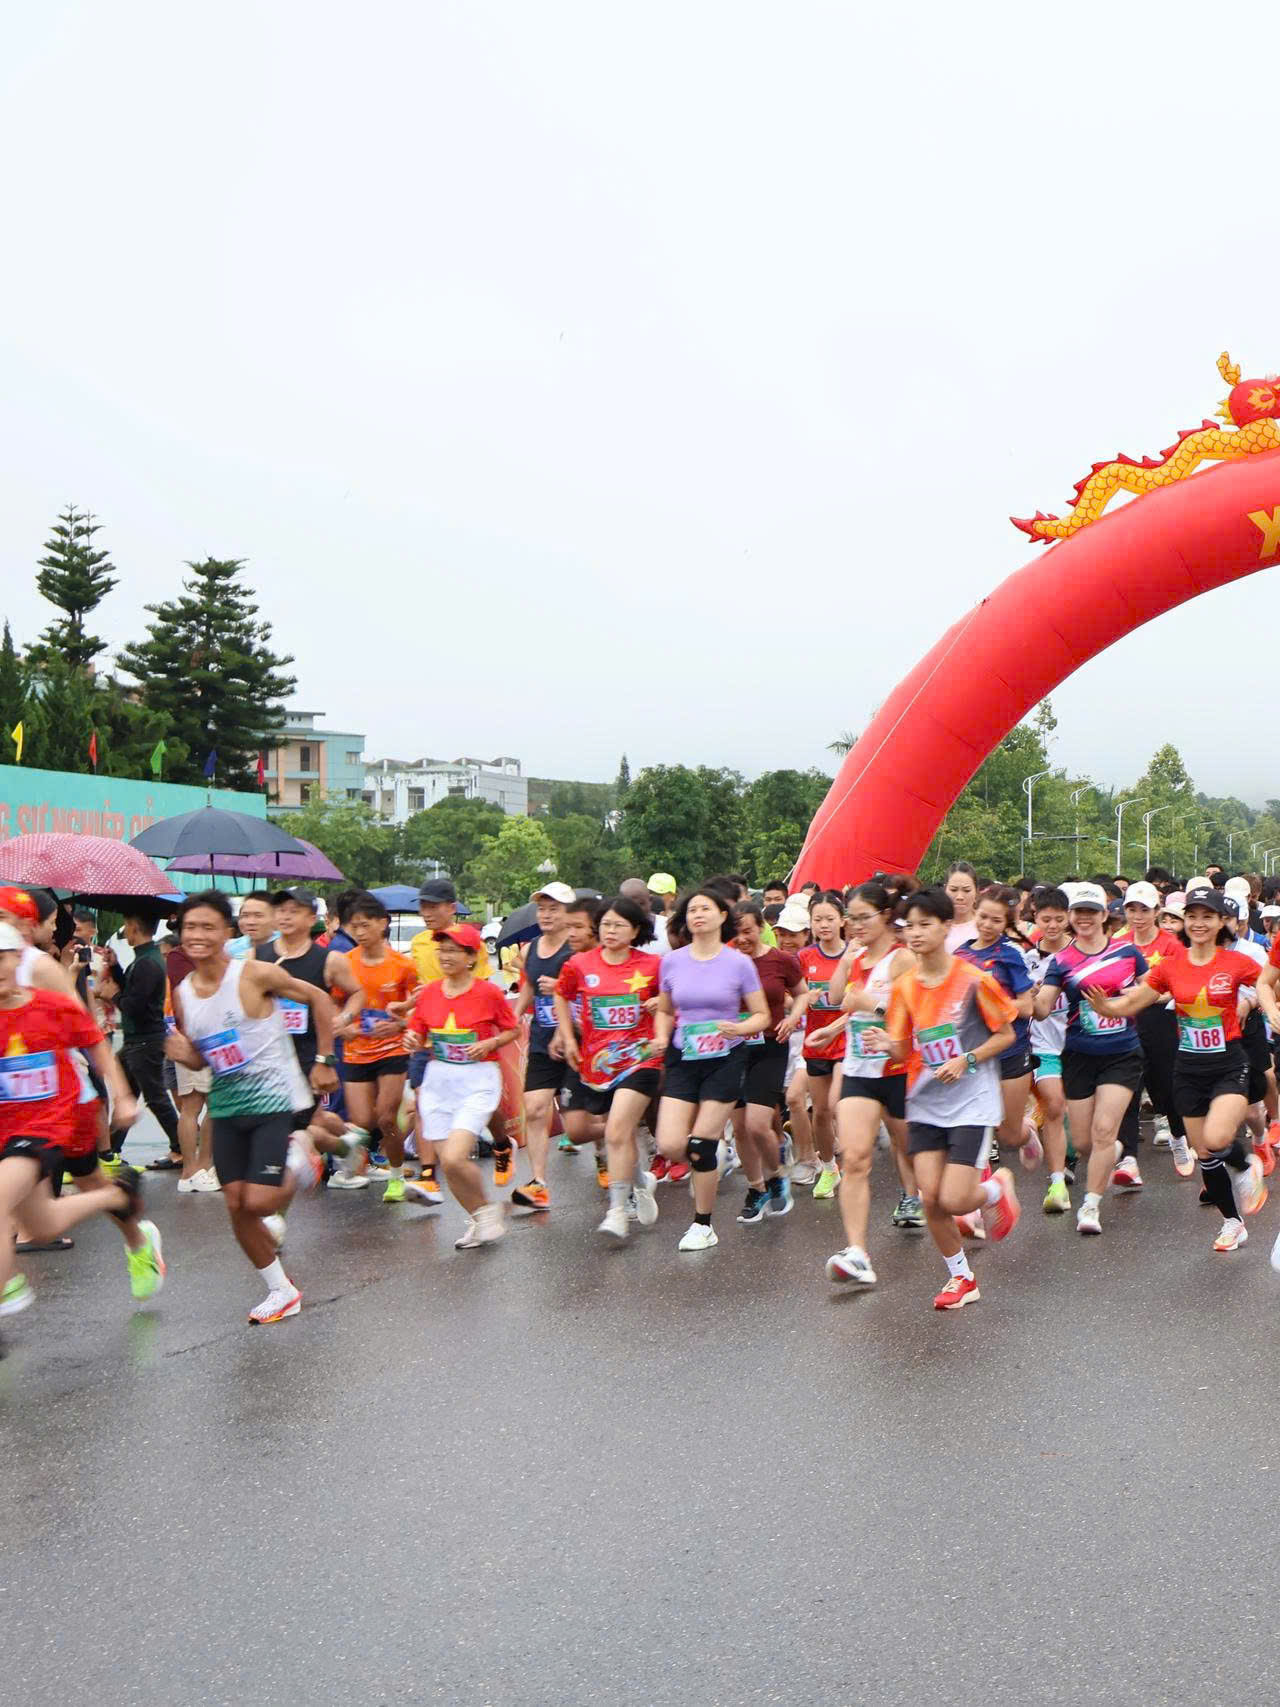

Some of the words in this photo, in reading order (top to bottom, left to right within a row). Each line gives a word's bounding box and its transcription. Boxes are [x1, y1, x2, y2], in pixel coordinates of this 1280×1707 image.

[608, 1007, 636, 1025] 285
[1194, 1029, 1220, 1048] 168
[923, 1039, 958, 1062] 112
